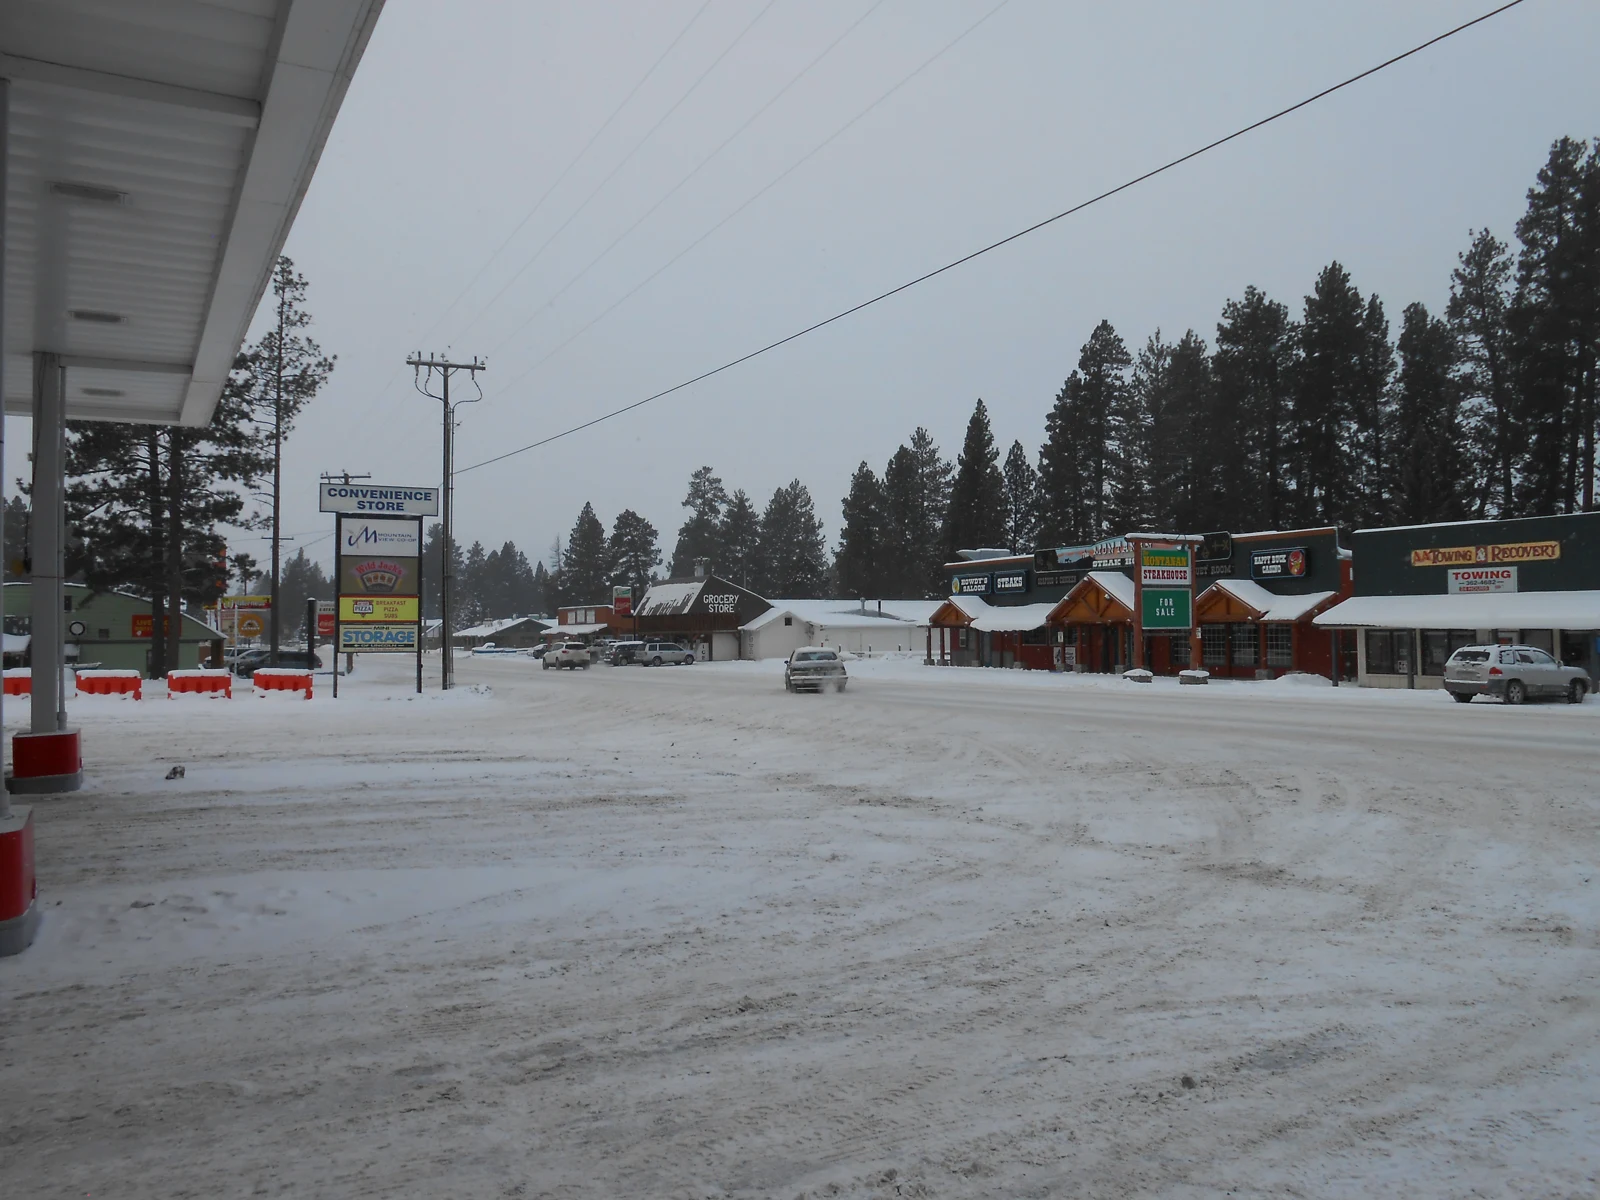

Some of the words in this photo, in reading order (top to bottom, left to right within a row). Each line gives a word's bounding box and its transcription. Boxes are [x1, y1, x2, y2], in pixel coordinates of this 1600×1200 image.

[327, 488, 432, 501] CONVENIENCE
[357, 500, 404, 511] STORE
[1092, 559, 1121, 567] STEAK
[1254, 556, 1271, 565] HAPPY
[355, 561, 376, 574] Wild
[1143, 569, 1188, 580] STEAKHOUSE
[1452, 570, 1511, 581] TOWING
[997, 576, 1023, 589] STEAKS
[963, 584, 986, 592] SALOON
[703, 594, 739, 604] GROCERY
[1159, 598, 1173, 606] FOR
[708, 604, 735, 613] STORE
[1155, 608, 1174, 616] SALE
[343, 630, 415, 643] STORAGE
